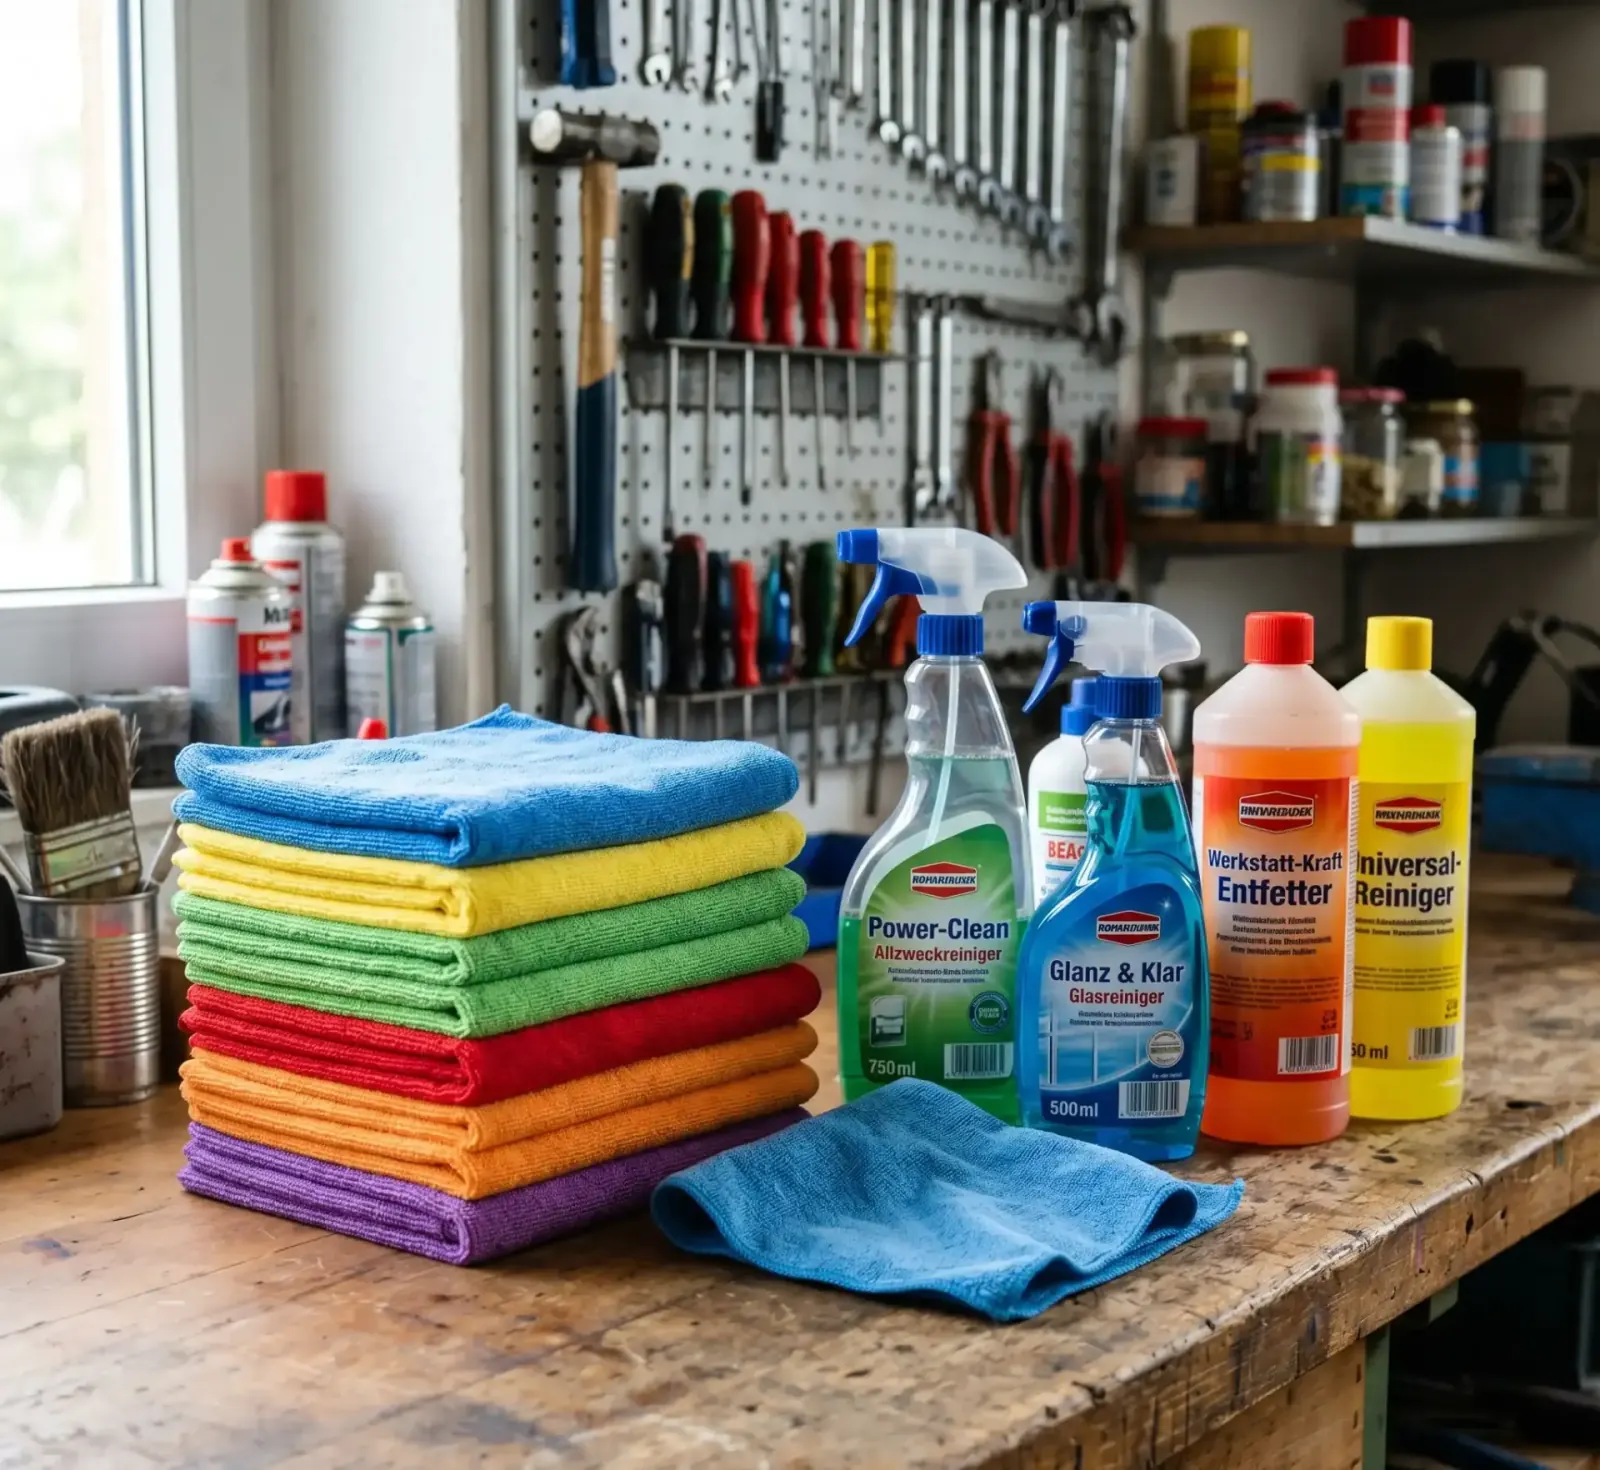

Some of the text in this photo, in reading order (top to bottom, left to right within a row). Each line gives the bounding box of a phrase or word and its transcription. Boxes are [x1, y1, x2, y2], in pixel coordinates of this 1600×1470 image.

[1208, 849, 1343, 872] Werkstatt-Kraft
[1357, 850, 1461, 876] niversal-
[1218, 876, 1333, 906] Entfetter
[1356, 879, 1454, 913] Reiniger
[868, 916, 1009, 940] Power-Clean
[874, 944, 1003, 965] Allzweckreiniger
[1050, 959, 1185, 984] Glanz & Klar
[1069, 987, 1165, 1008] Glasreiniger
[1369, 1043, 1389, 1060] ml
